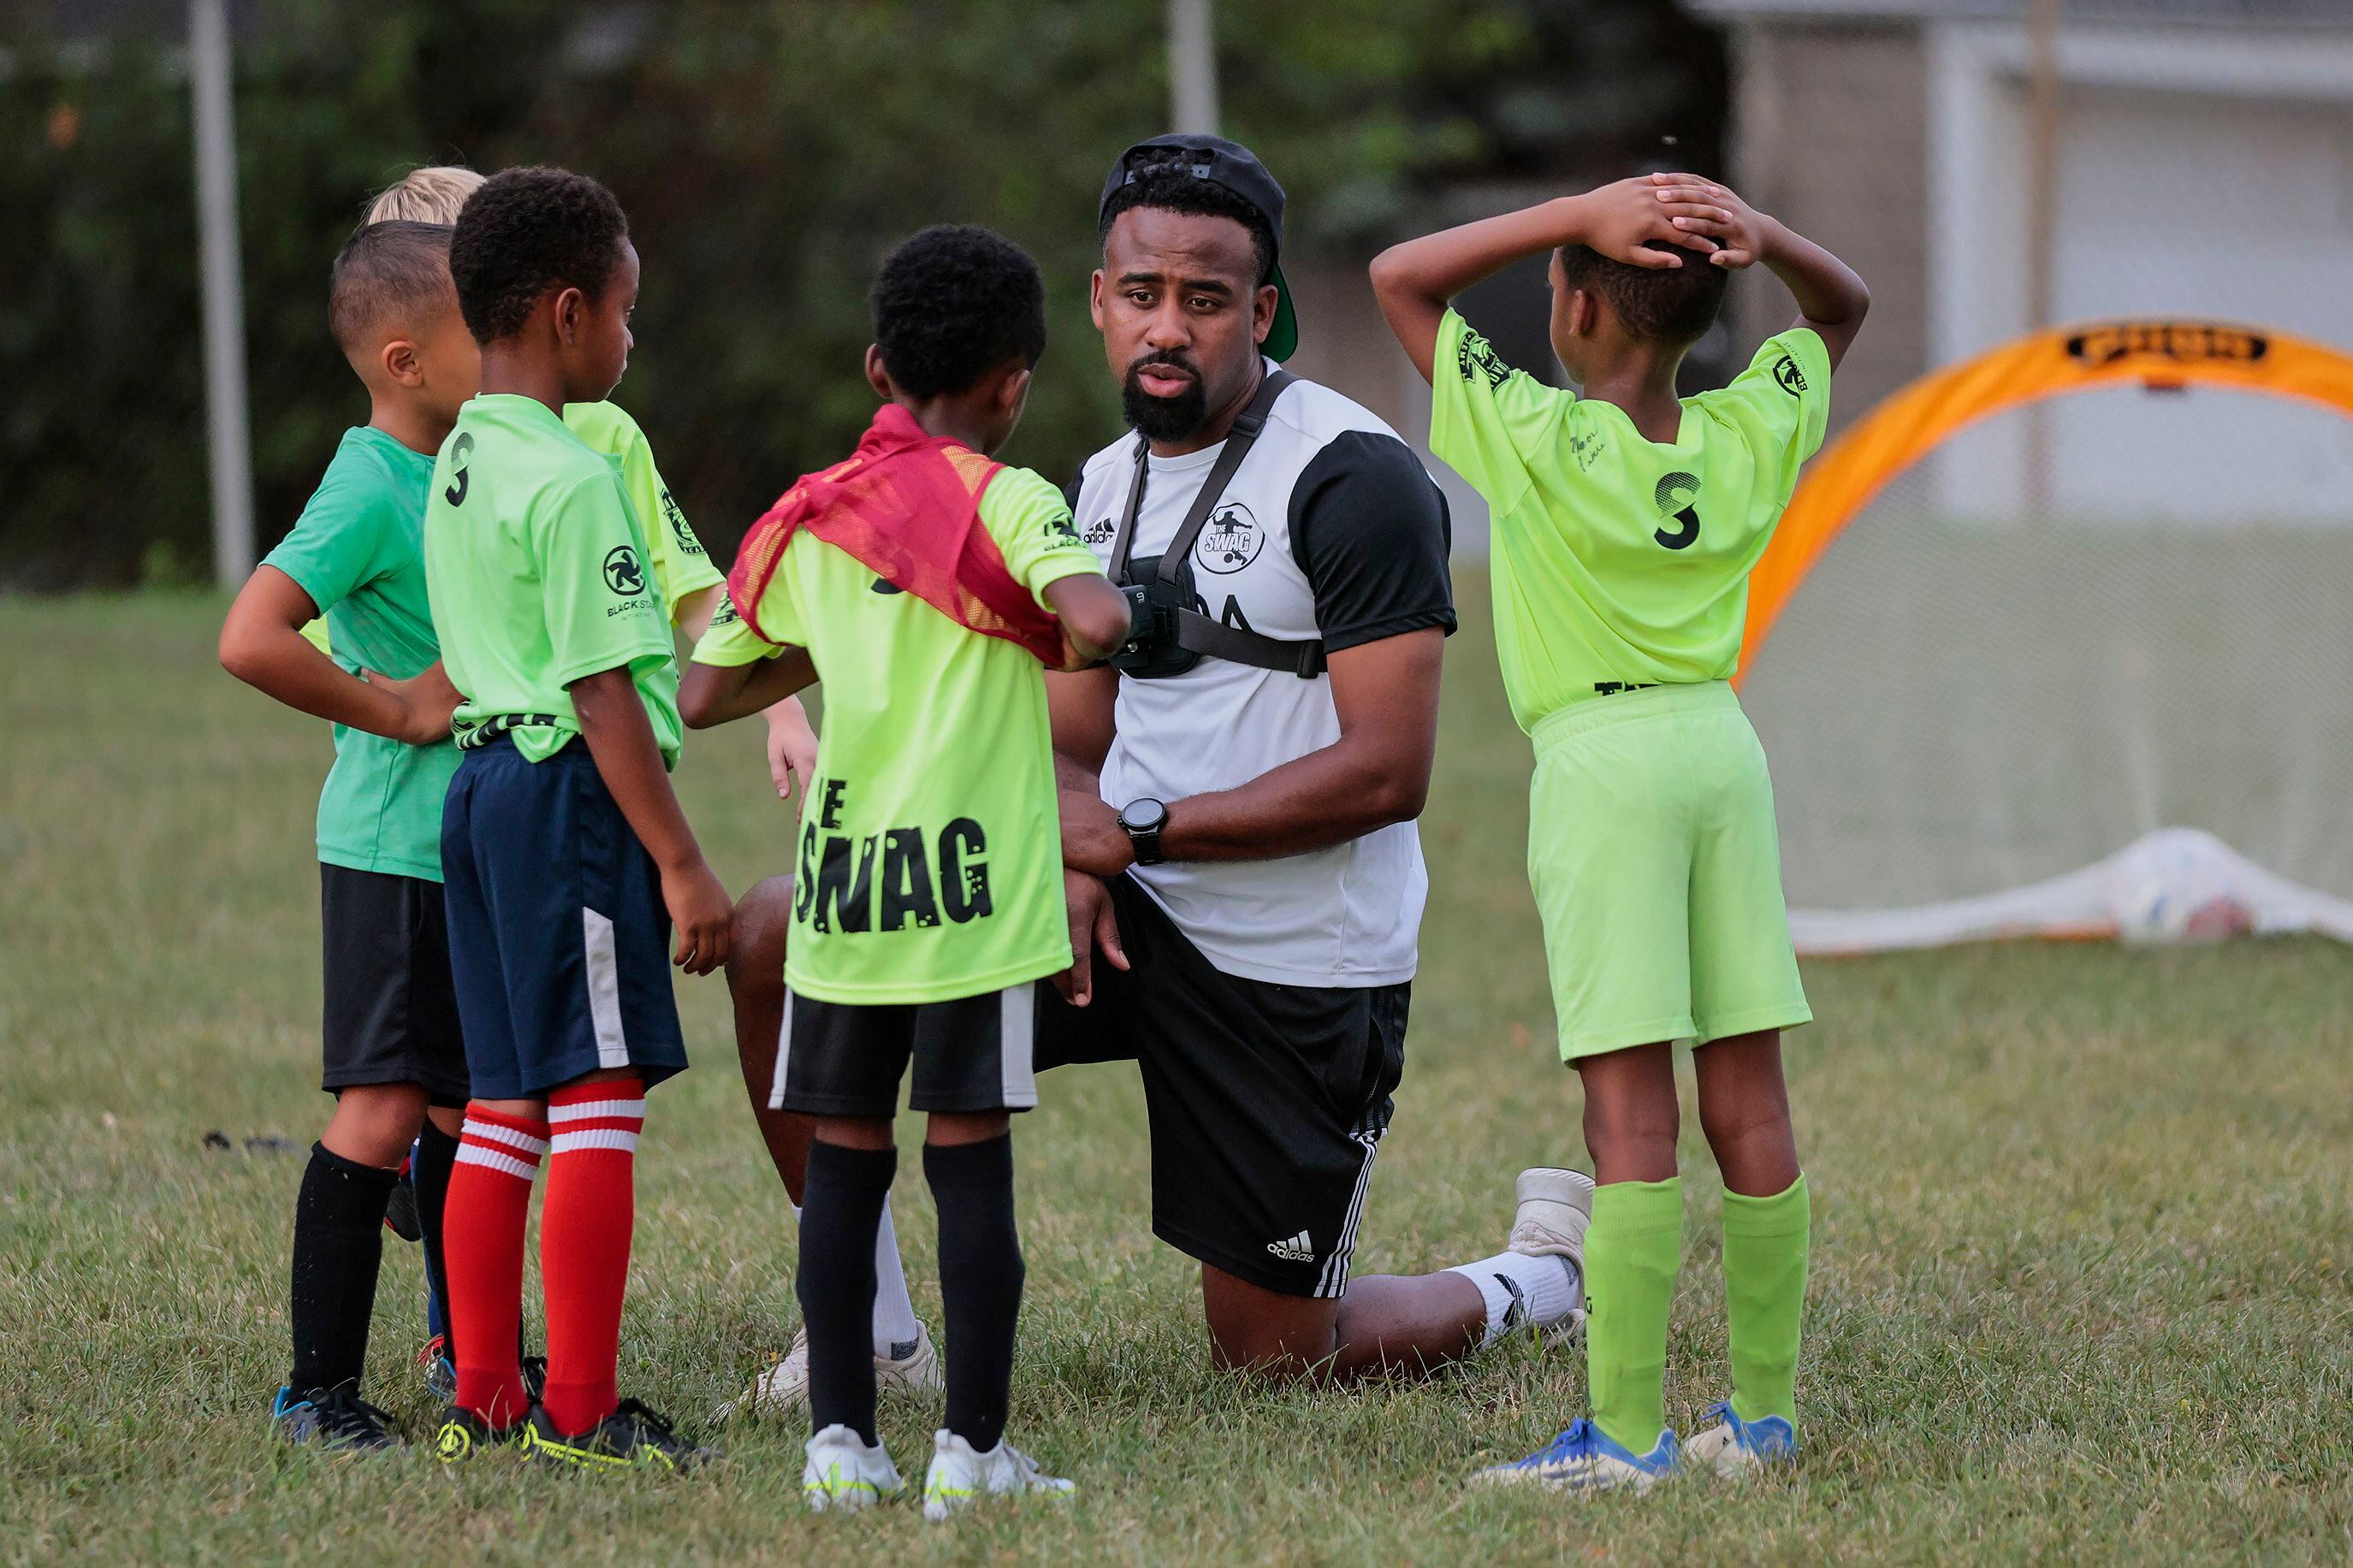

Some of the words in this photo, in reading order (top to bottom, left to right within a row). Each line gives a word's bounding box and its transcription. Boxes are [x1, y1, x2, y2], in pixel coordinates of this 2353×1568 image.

[1083, 530, 1114, 544] adida
[1205, 532, 1251, 552] SWAG
[607, 600, 638, 617] BLACK
[1266, 1243, 1315, 1263] adidas
